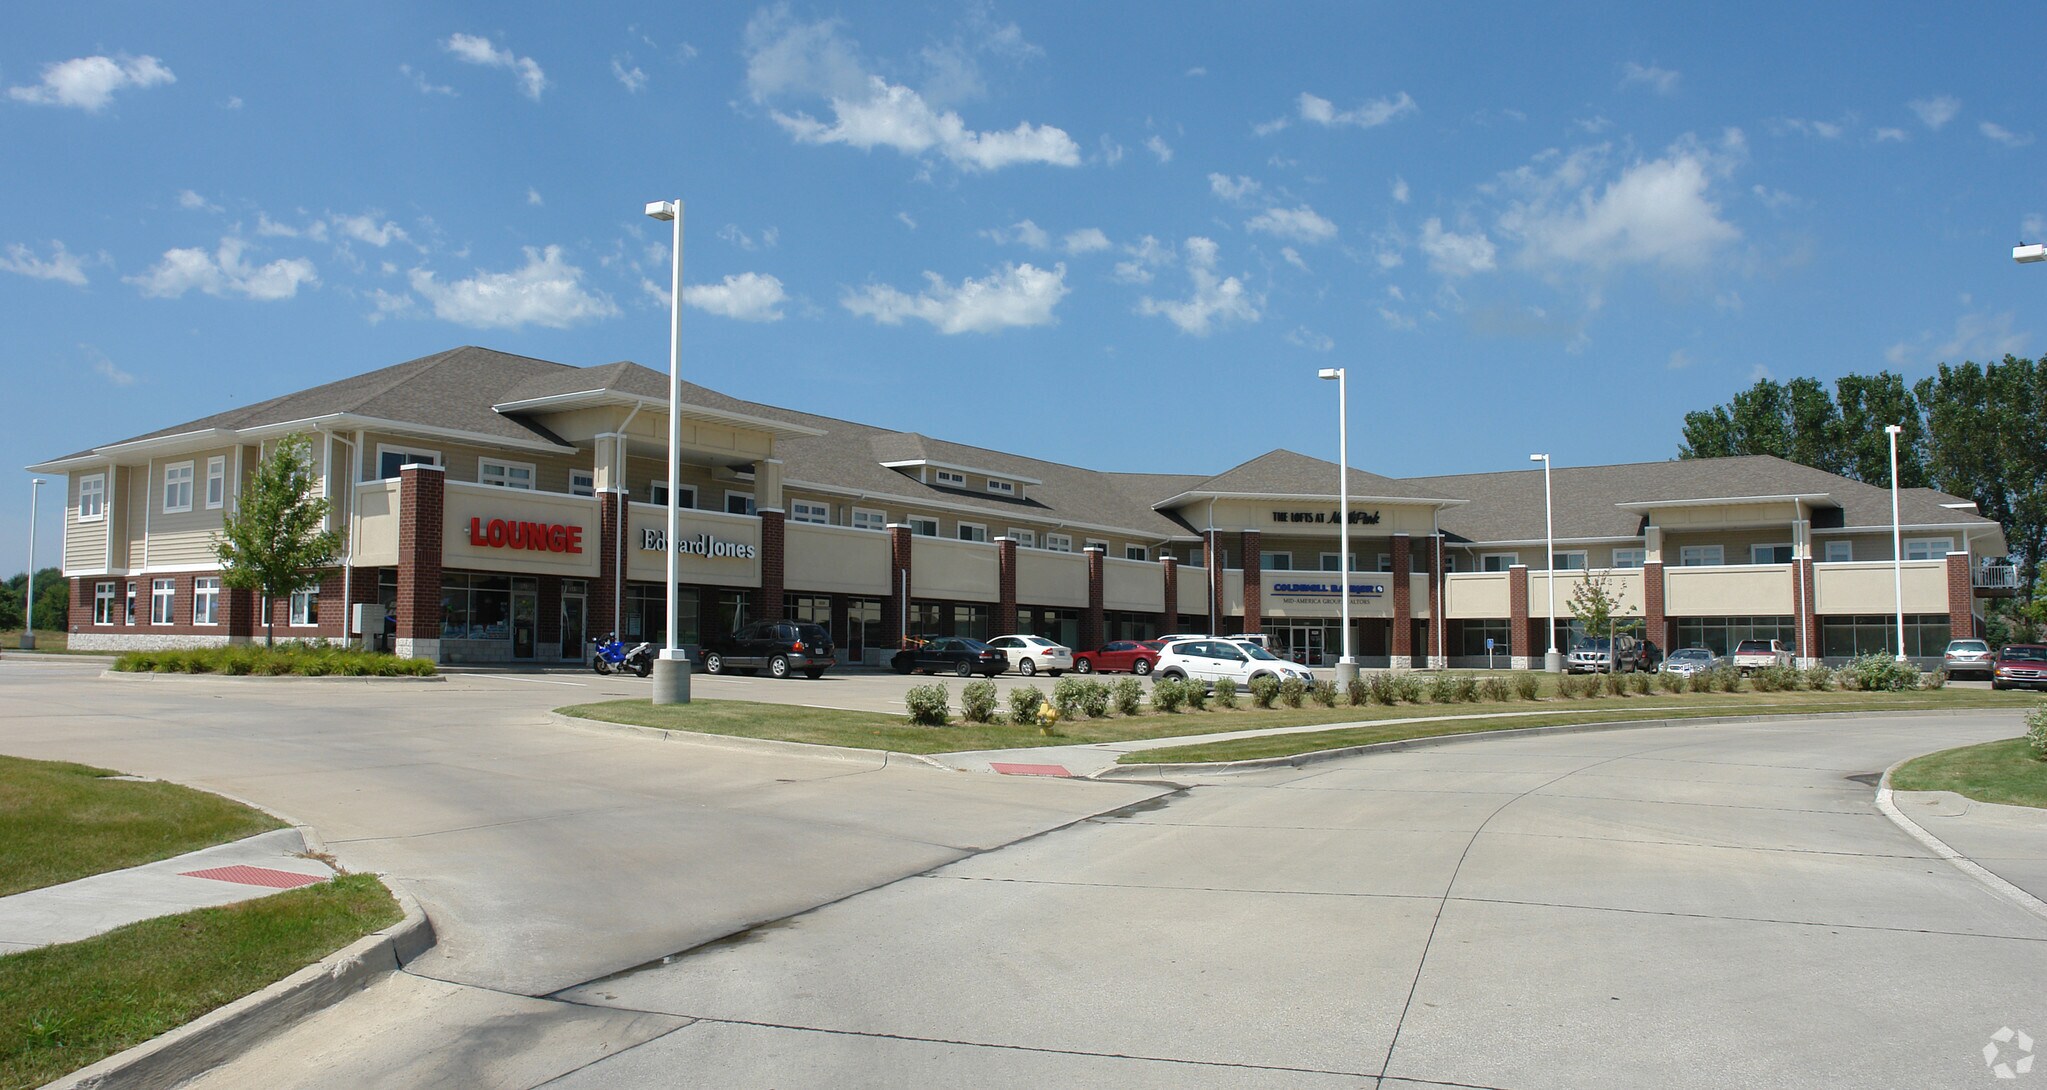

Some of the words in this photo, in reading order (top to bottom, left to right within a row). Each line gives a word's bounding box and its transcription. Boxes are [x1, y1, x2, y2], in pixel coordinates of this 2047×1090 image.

[1273, 512, 1288, 522] THE
[1291, 512, 1313, 523] LOFTS
[1315, 513, 1325, 523] AT
[470, 517, 582, 554] LOUNGE
[1273, 584, 1328, 592] COLDWELL
